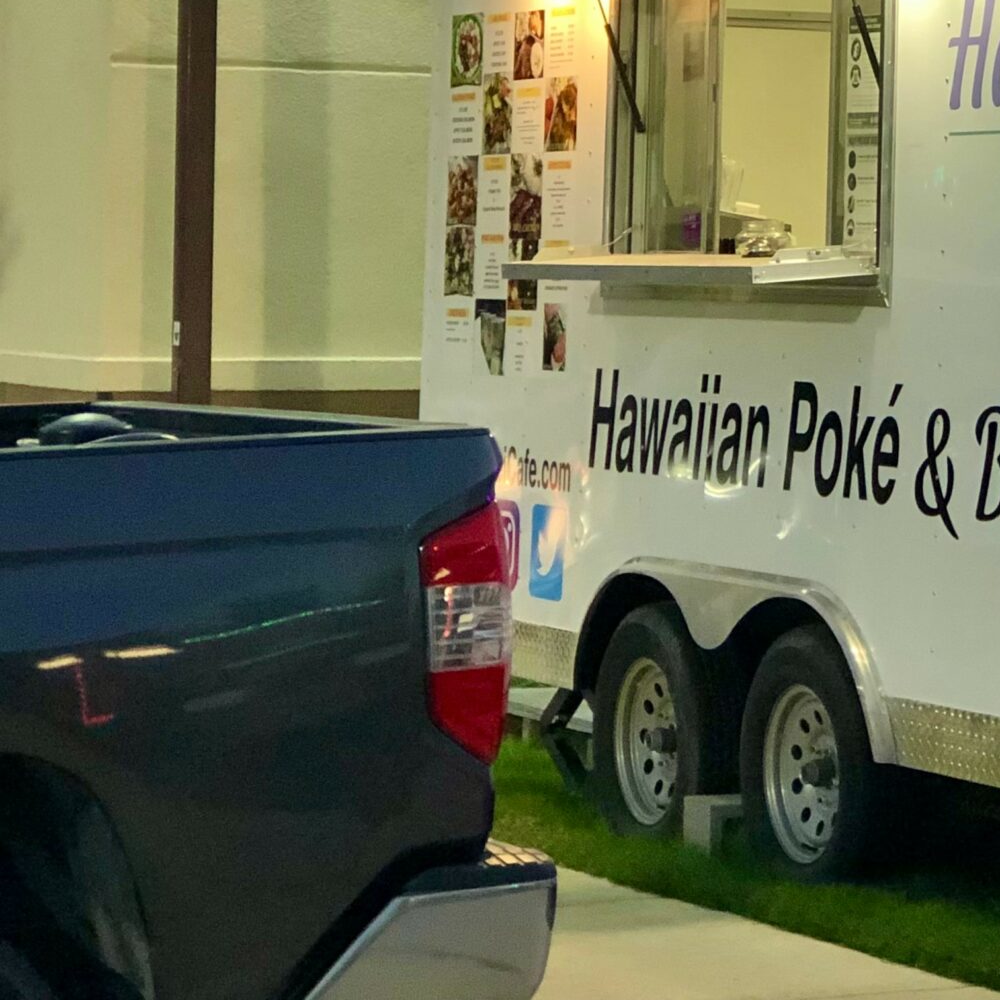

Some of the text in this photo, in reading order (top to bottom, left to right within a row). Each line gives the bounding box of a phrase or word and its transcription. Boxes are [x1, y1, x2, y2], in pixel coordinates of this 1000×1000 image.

[590, 368, 771, 488] Hawaiian
[783, 380, 905, 505] Poké
[914, 407, 960, 540] &
